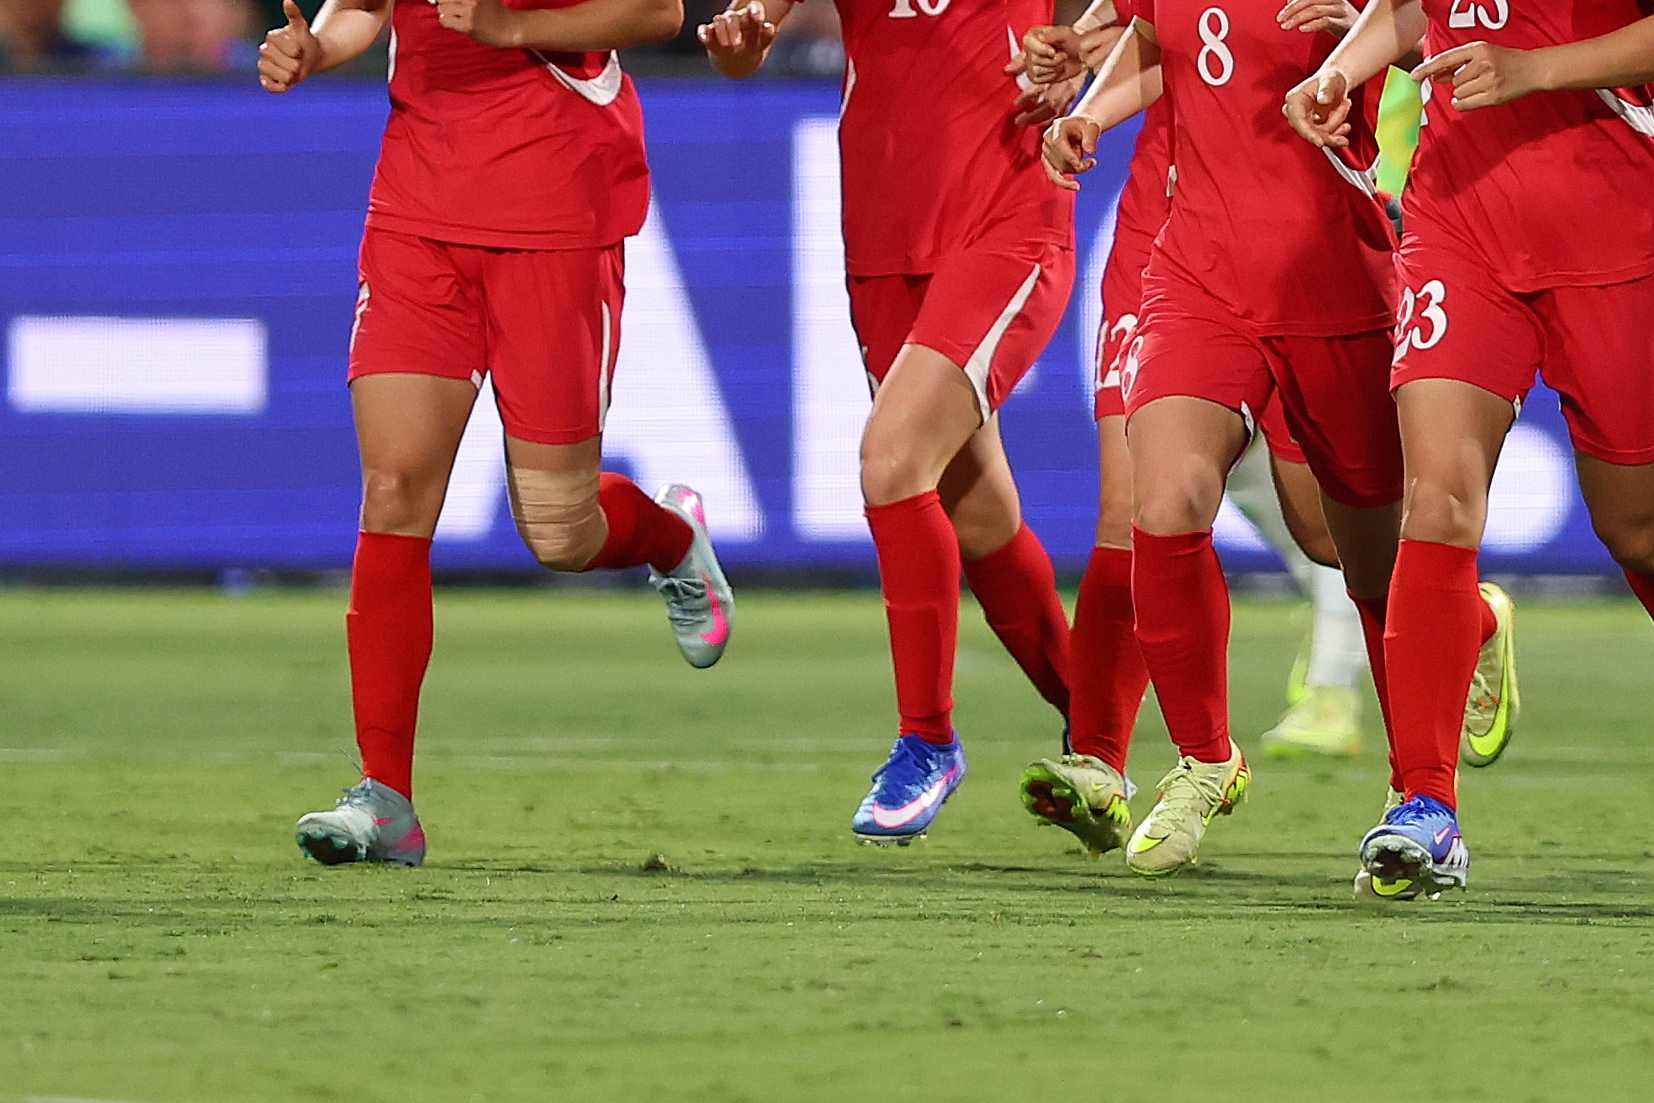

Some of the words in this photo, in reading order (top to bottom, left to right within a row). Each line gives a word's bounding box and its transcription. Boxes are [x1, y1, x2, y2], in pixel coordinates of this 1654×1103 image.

[1198, 7, 1234, 86] 8
[1096, 313, 1138, 391] 12
[1392, 279, 1448, 365] 23
[1121, 335, 1144, 401] 8
